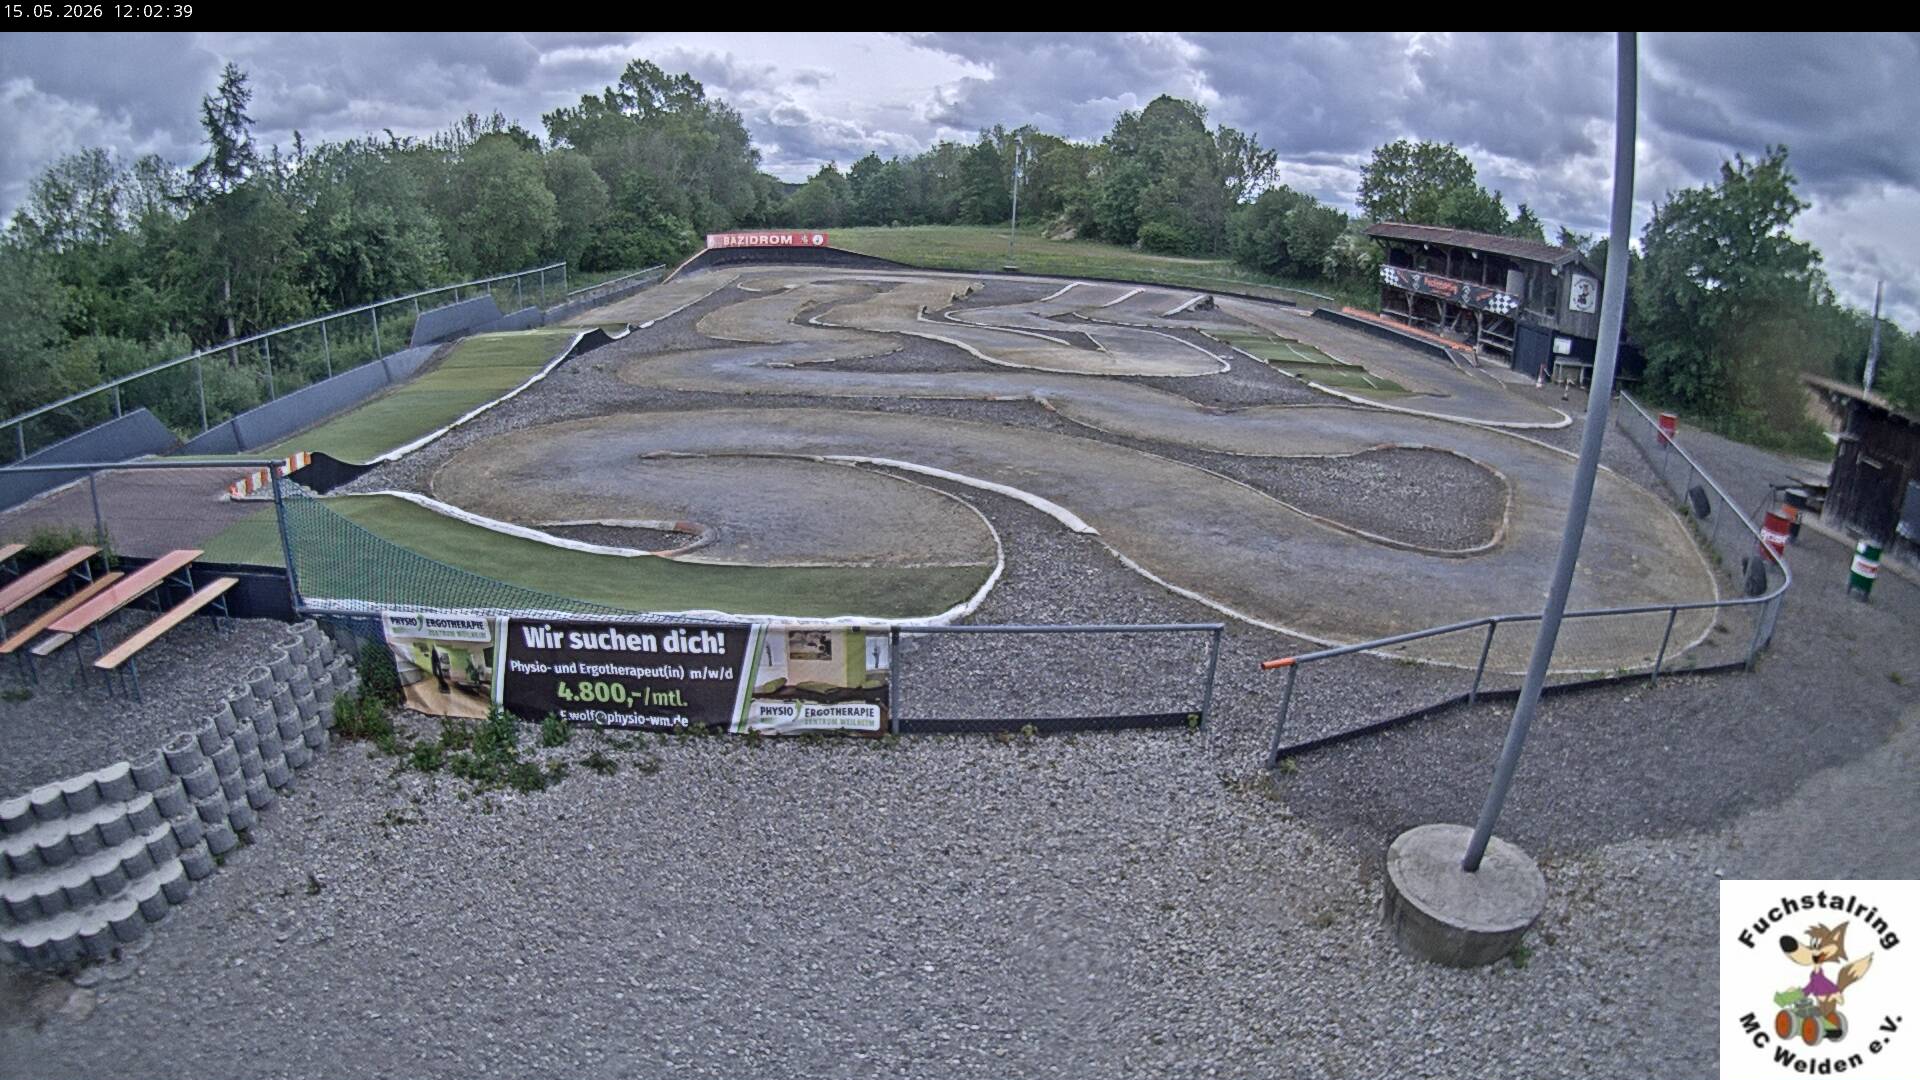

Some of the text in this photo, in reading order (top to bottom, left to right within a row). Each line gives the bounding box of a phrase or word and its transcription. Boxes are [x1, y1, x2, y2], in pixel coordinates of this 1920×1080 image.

[723, 235, 793, 246] BAZIDROM
[390, 616, 485, 630] PHYSIO ERGOTHERAPIE
[522, 624, 725, 654] Wir suchen dich!
[511, 660, 733, 680] Physio- und Ergotherapeut(in) m/w/d
[760, 706, 875, 717] PHYSIO ERGOTHERAPIE
